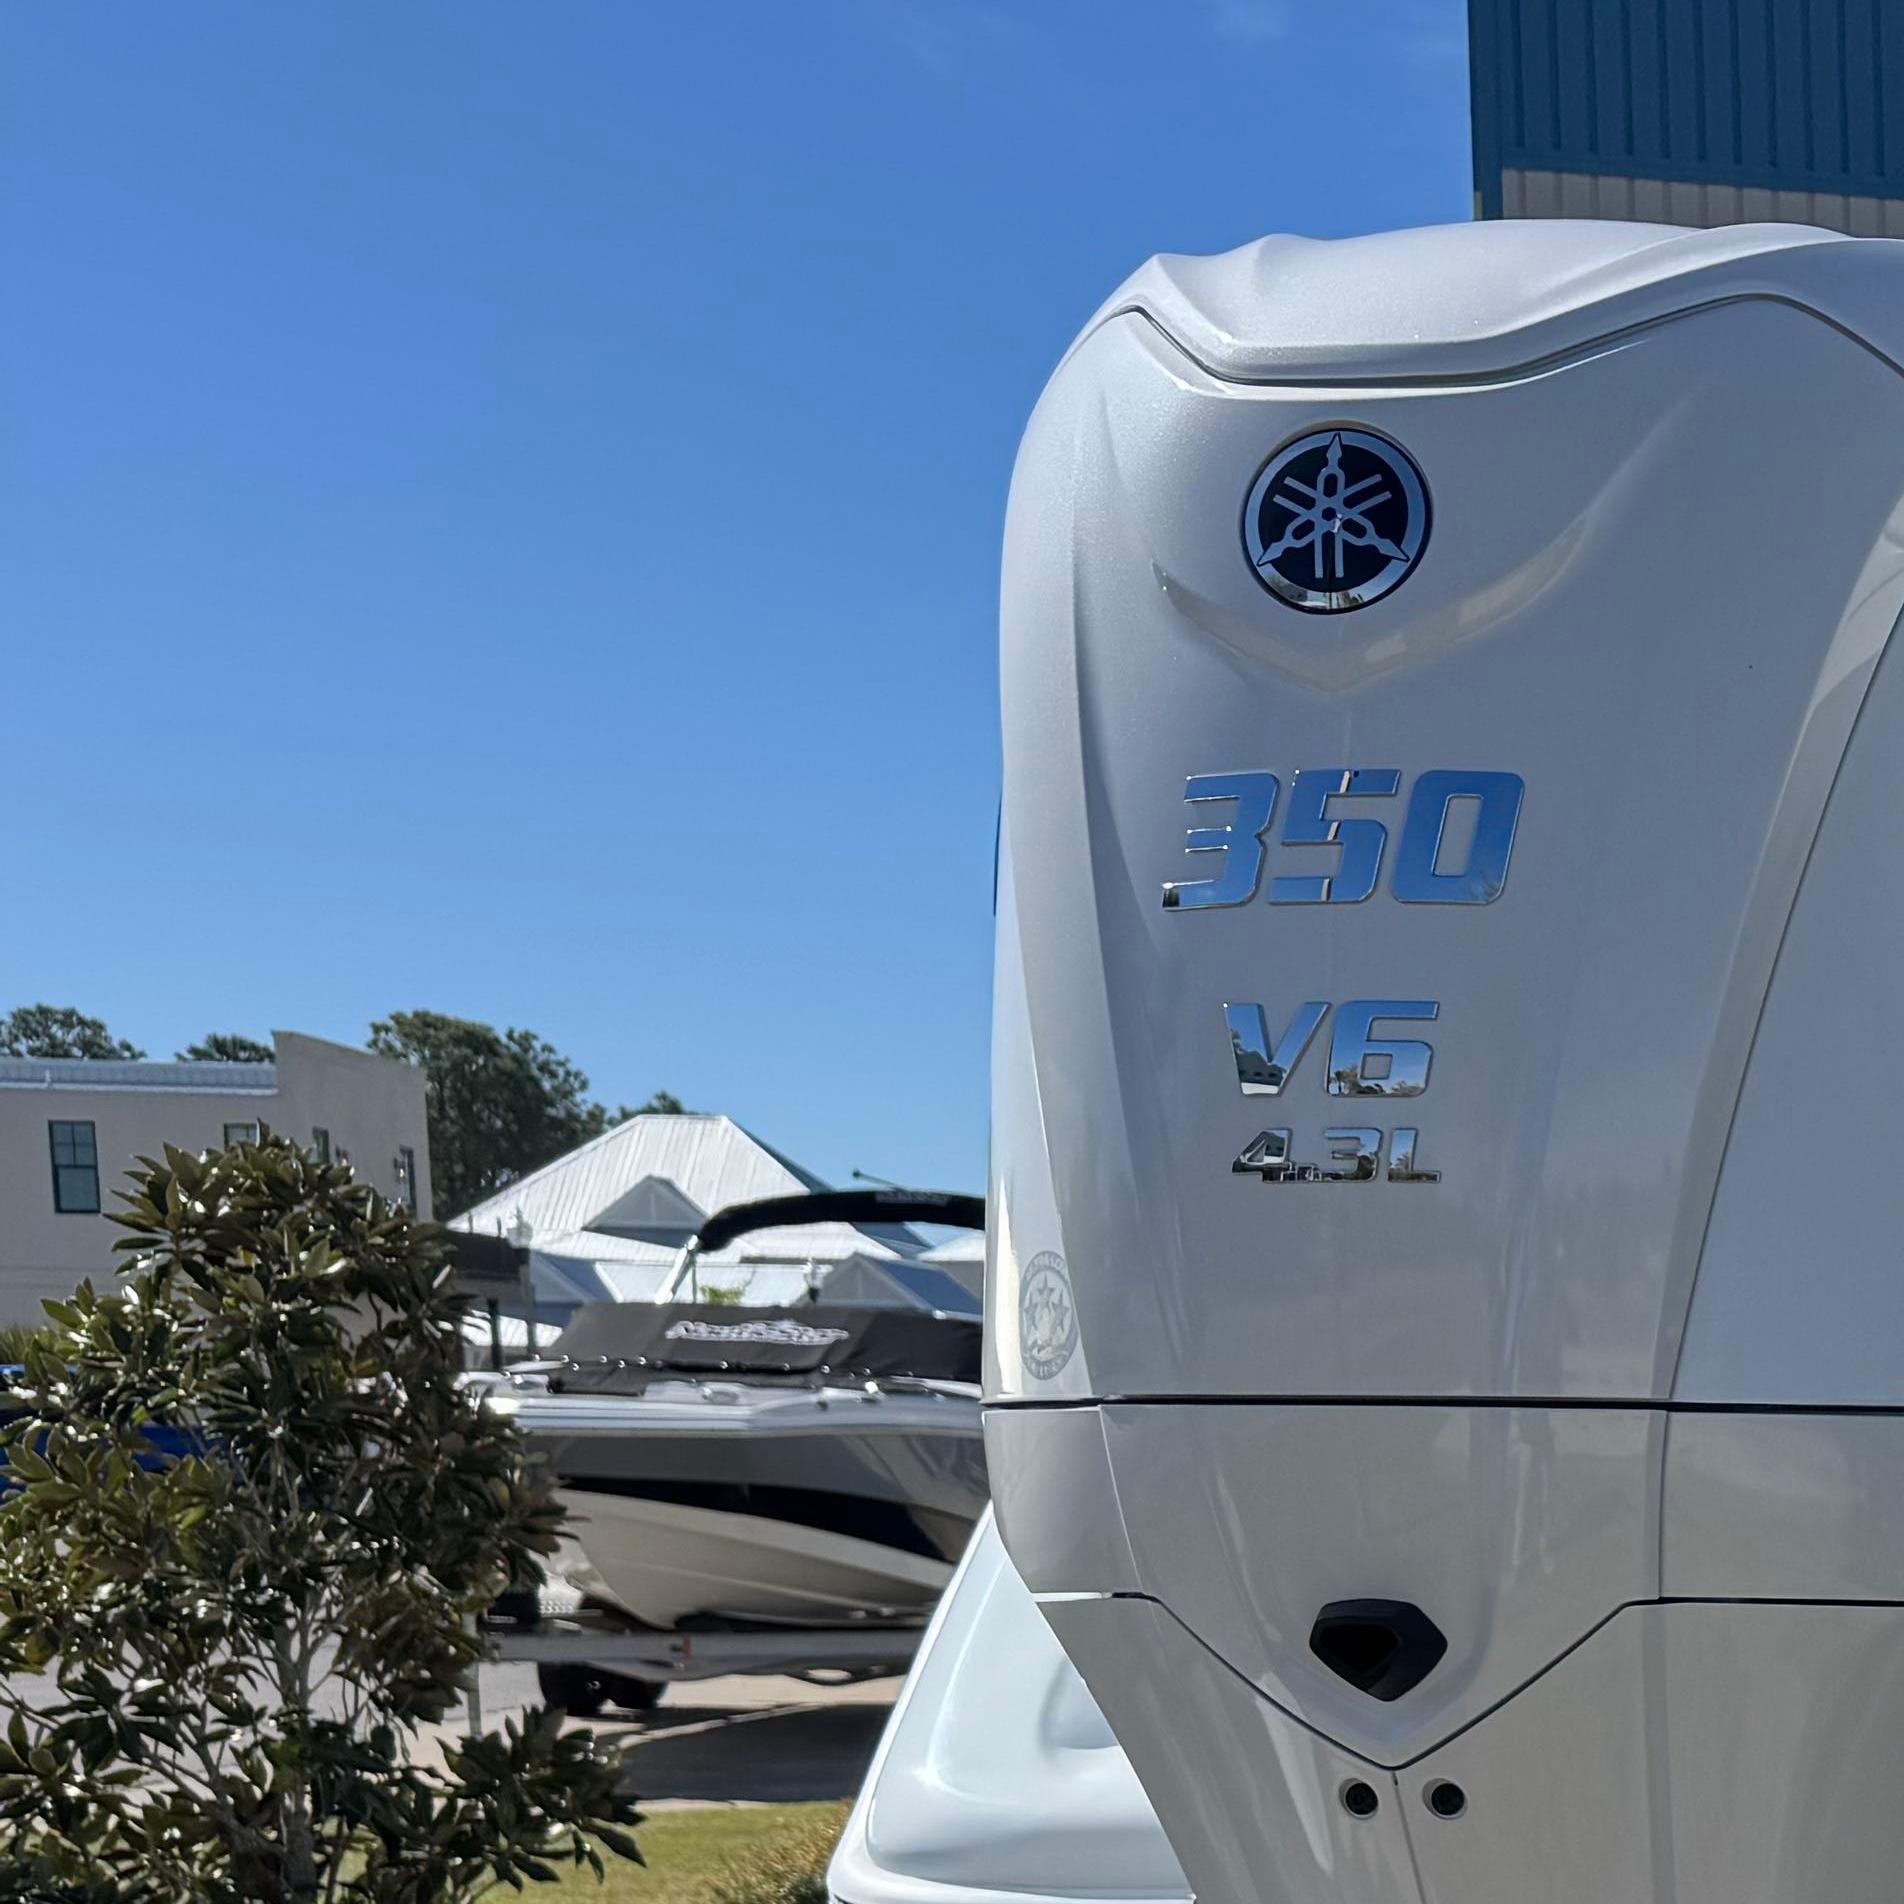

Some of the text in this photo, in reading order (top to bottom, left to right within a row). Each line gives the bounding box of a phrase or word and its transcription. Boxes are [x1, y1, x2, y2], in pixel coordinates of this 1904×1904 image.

[1162, 769, 1526, 912] 350
[1223, 1000, 1440, 1098] V6
[1231, 1127, 1442, 1184] 4.3L
